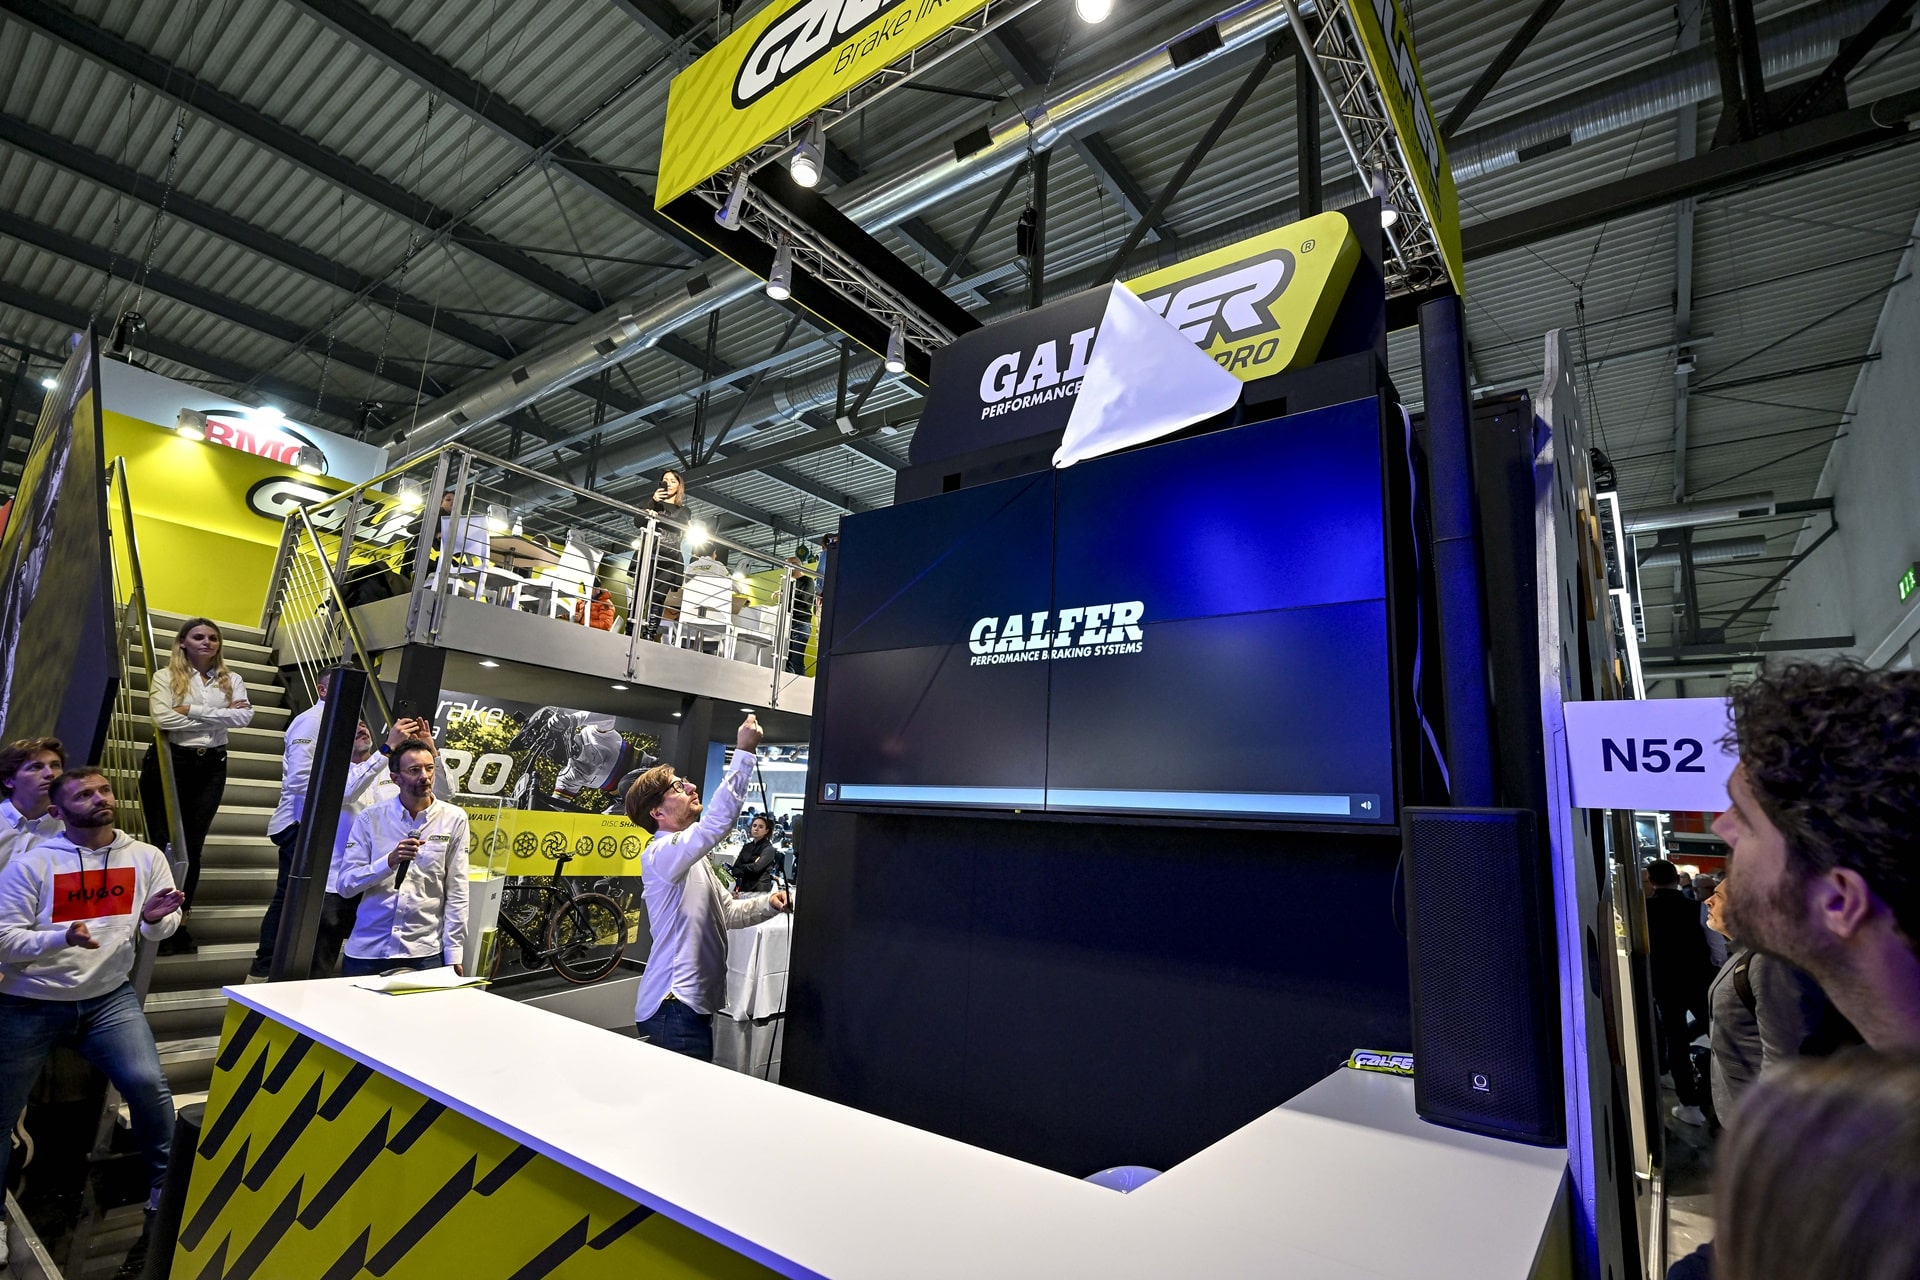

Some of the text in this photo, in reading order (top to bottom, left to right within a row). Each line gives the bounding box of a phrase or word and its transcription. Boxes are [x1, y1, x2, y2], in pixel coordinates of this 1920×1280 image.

[833, 9, 911, 76] Brake
[979, 327, 1096, 403] GAL
[1213, 337, 1280, 371] PRO
[981, 383, 1082, 420] PERFORMANCE
[968, 600, 1145, 655] GALFER
[970, 641, 1144, 666] PERFORMANCE BRAKING SYSTEMS
[434, 699, 505, 726] rake
[438, 747, 514, 795] RO
[1601, 737, 1706, 773] N52
[468, 813, 496, 822] WAVE
[601, 819, 619, 828] DISC
[67, 884, 124, 903] HUGO
[1354, 1053, 1415, 1070] GALFE
